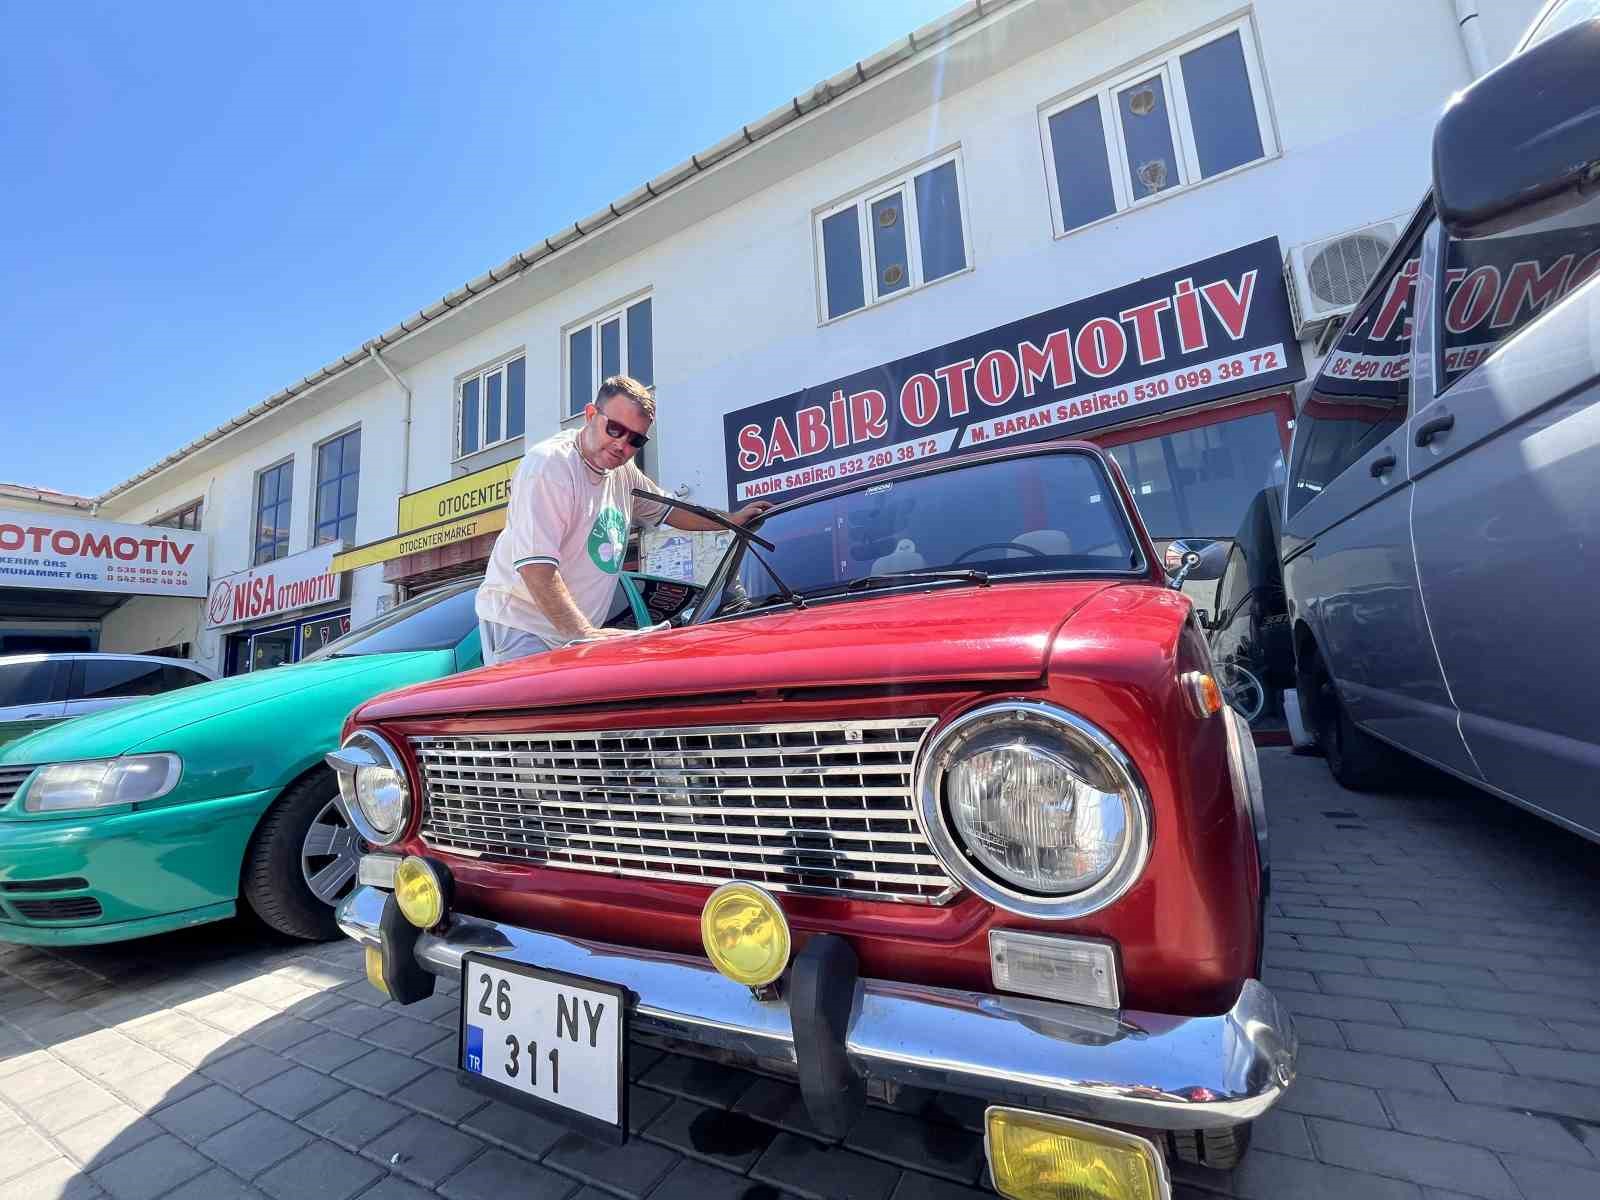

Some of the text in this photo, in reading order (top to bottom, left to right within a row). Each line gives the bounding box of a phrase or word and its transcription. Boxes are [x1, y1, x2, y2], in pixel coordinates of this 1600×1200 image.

[738, 269, 1258, 471] SABİR OTOMOTİV
[971, 425, 990, 443] M.
[994, 409, 1052, 437] BARAN
[1135, 379, 1169, 402] 530
[1174, 365, 1212, 391] 099
[1218, 358, 1245, 381] 38
[1250, 350, 1277, 374] 72
[745, 480, 782, 498] NADİR
[839, 459, 864, 477] 532
[867, 451, 893, 471] 260
[897, 446, 915, 463] 38
[918, 439, 937, 458] 72
[439, 479, 512, 517] OTOCENTER
[0, 524, 195, 566] OTOMOTİV
[400, 522, 478, 554] OTOCENTER MARKET
[232, 567, 337, 621] NİSA OTOMOTİV
[478, 973, 605, 1048] 26 NY
[468, 1054, 481, 1072] TR
[504, 1034, 560, 1093] 311
